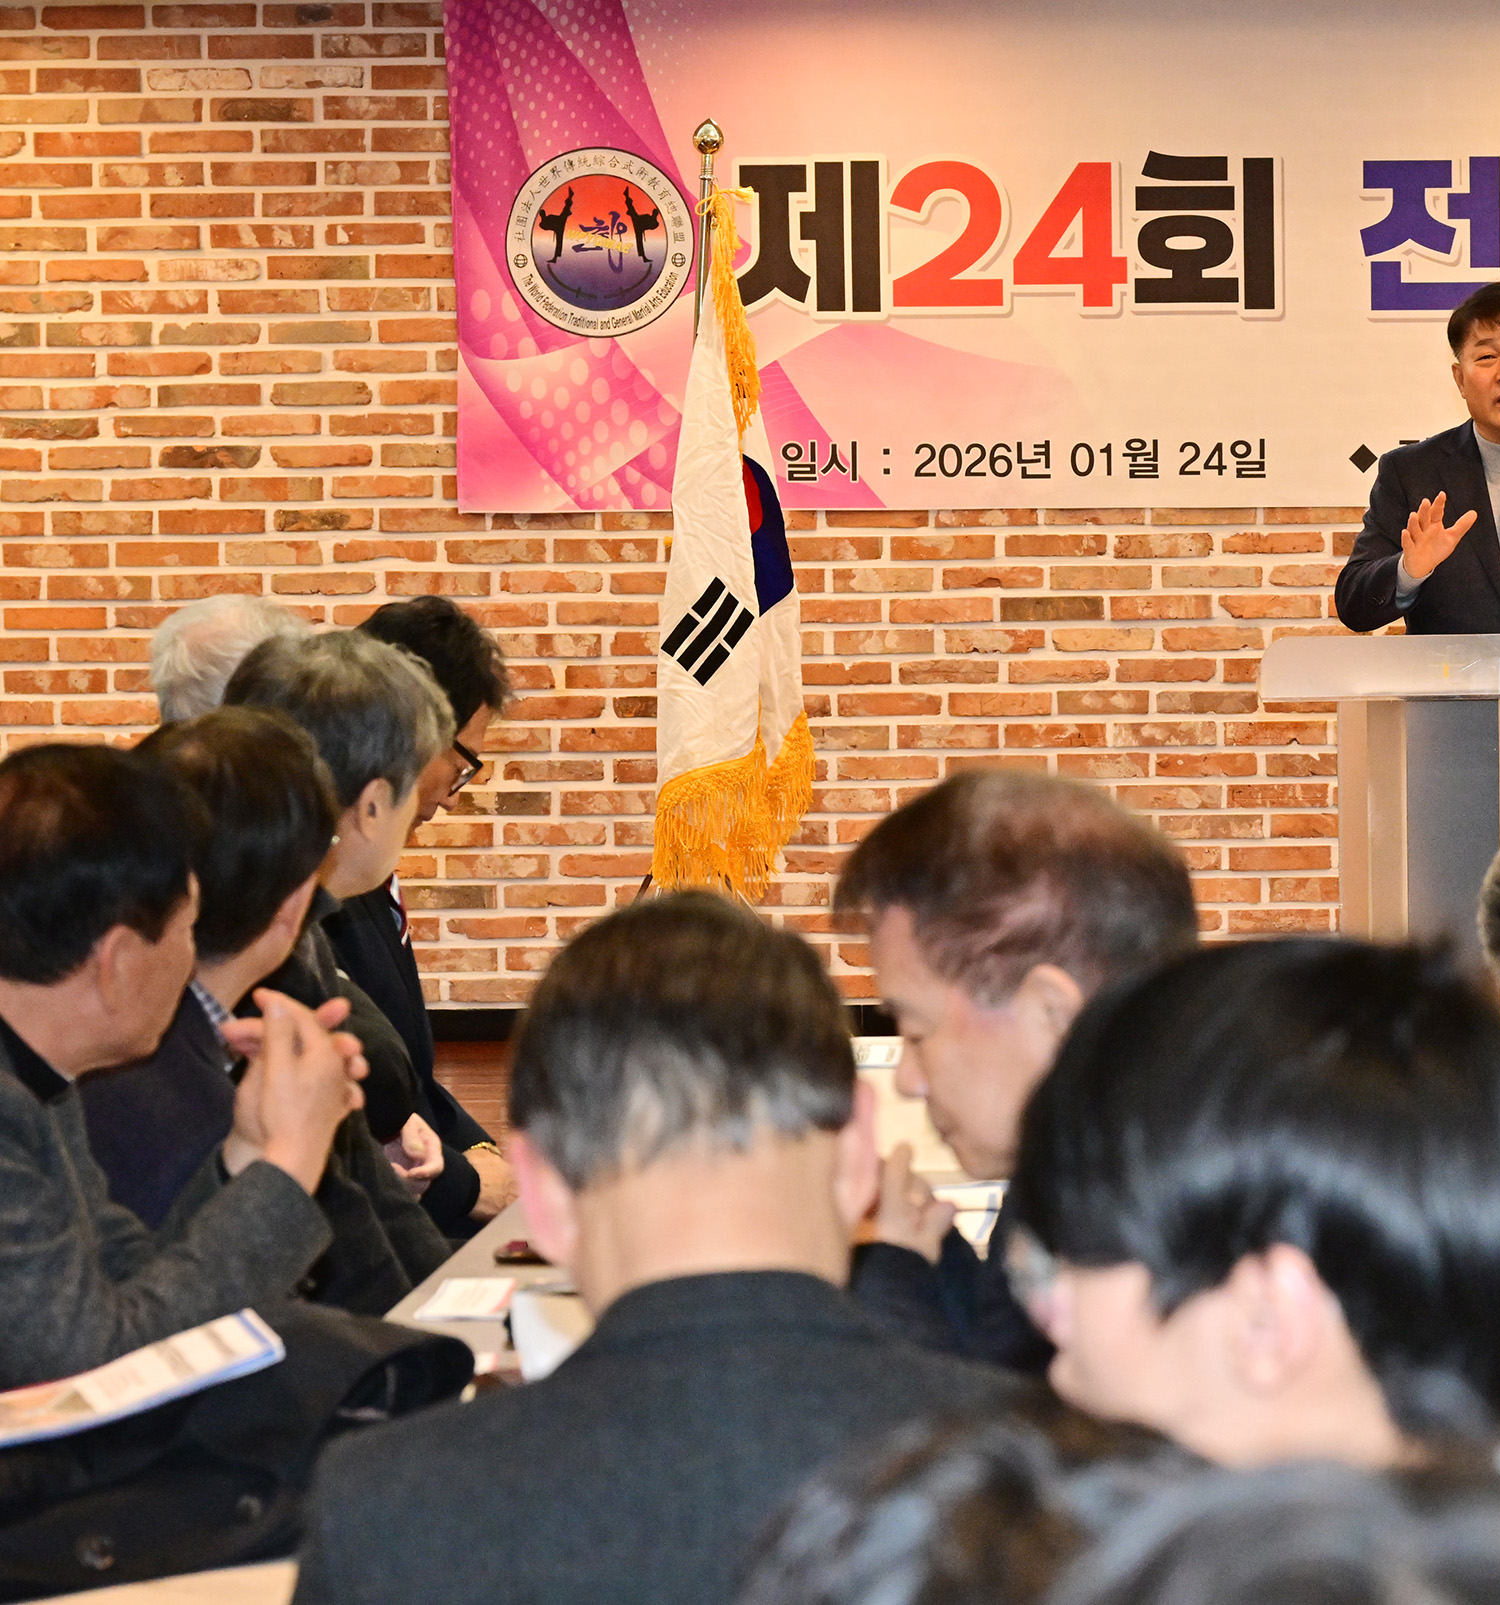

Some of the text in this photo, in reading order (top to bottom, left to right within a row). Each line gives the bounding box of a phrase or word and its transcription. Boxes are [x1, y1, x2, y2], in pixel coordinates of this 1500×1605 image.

[737, 151, 1276, 312] 제24회
[528, 283, 545, 303] World
[540, 296, 568, 322] Federation
[568, 312, 598, 330] Traditional
[600, 318, 611, 330] and
[611, 312, 634, 329] General
[631, 302, 653, 321] Martial
[648, 295, 663, 310] Arts
[656, 271, 679, 299] Education
[780, 440, 858, 482] 일시
[914, 440, 1052, 479] 2026년
[1070, 438, 1160, 479] 01월
[1178, 438, 1267, 478] 24일
